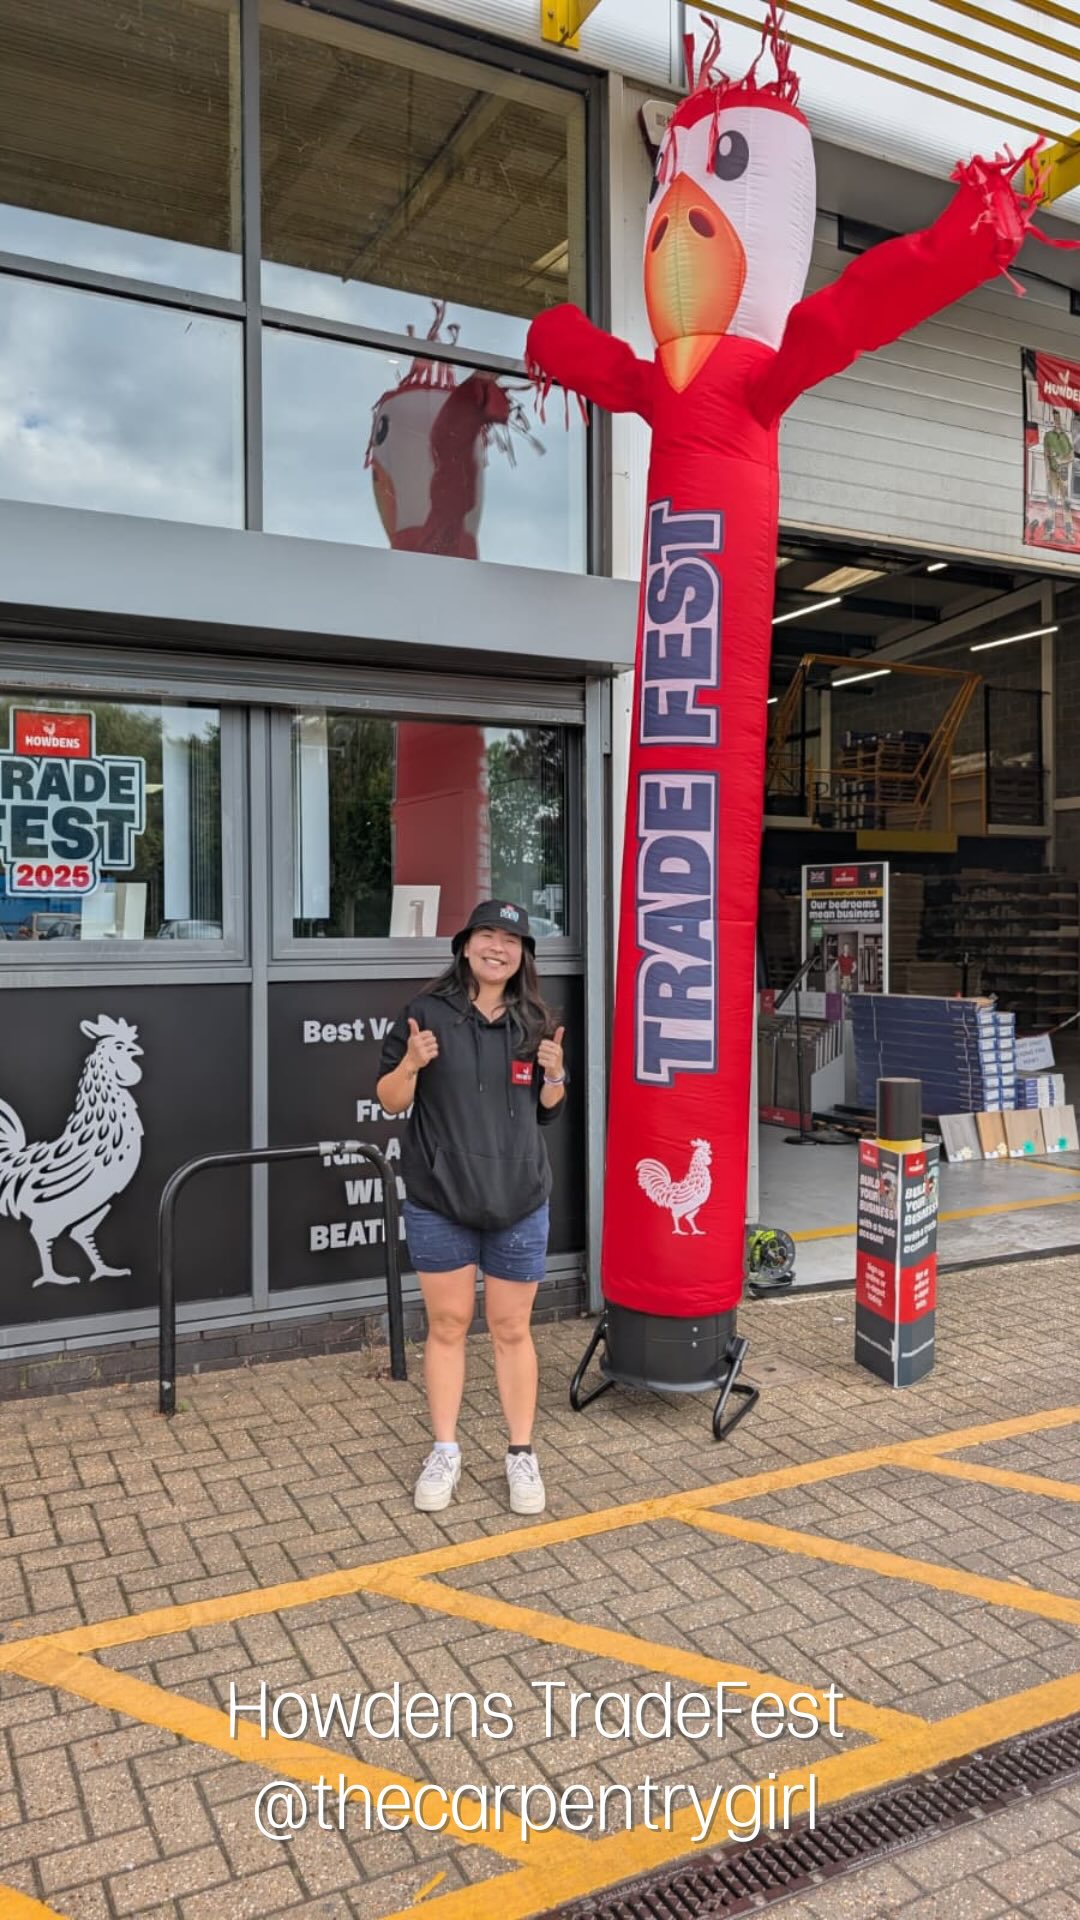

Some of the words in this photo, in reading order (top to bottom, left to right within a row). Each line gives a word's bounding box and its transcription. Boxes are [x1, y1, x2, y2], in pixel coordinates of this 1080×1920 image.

[640, 500, 721, 744] FEST
[25, 735, 80, 749] HOWDENS
[0, 760, 135, 805] RADE
[0, 805, 135, 861] EST
[16, 864, 90, 888] 2025
[637, 774, 716, 1082] TRADE
[304, 1018, 364, 1043] Best
[357, 1099, 414, 1122] Fr
